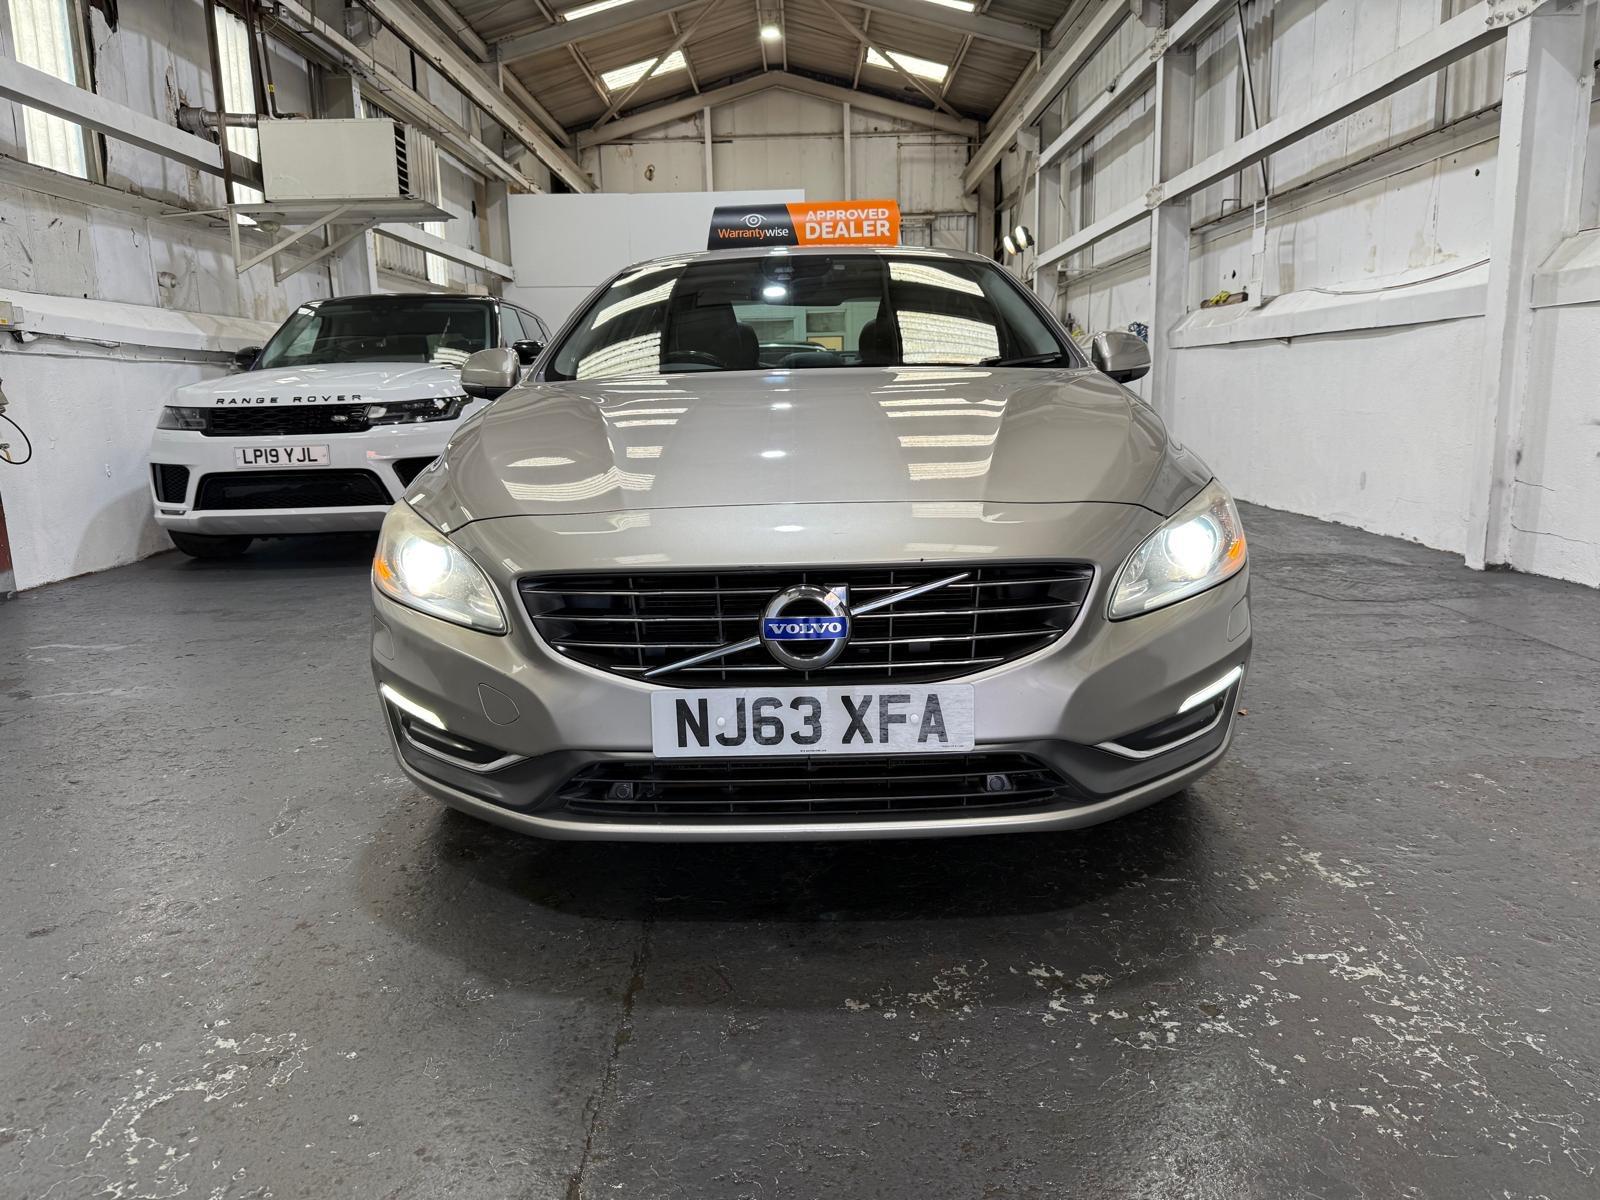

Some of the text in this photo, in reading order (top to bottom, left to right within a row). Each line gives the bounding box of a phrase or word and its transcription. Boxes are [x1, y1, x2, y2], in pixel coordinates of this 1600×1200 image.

[806, 208, 889, 221] APPROVED
[718, 227, 789, 240] Warrantywise
[805, 221, 890, 239] DEALER
[216, 394, 362, 405] RANGE ROVER
[242, 447, 318, 464] LP19 YJL
[768, 622, 843, 634] VOLVO
[675, 694, 949, 748] NJ63 XFA
